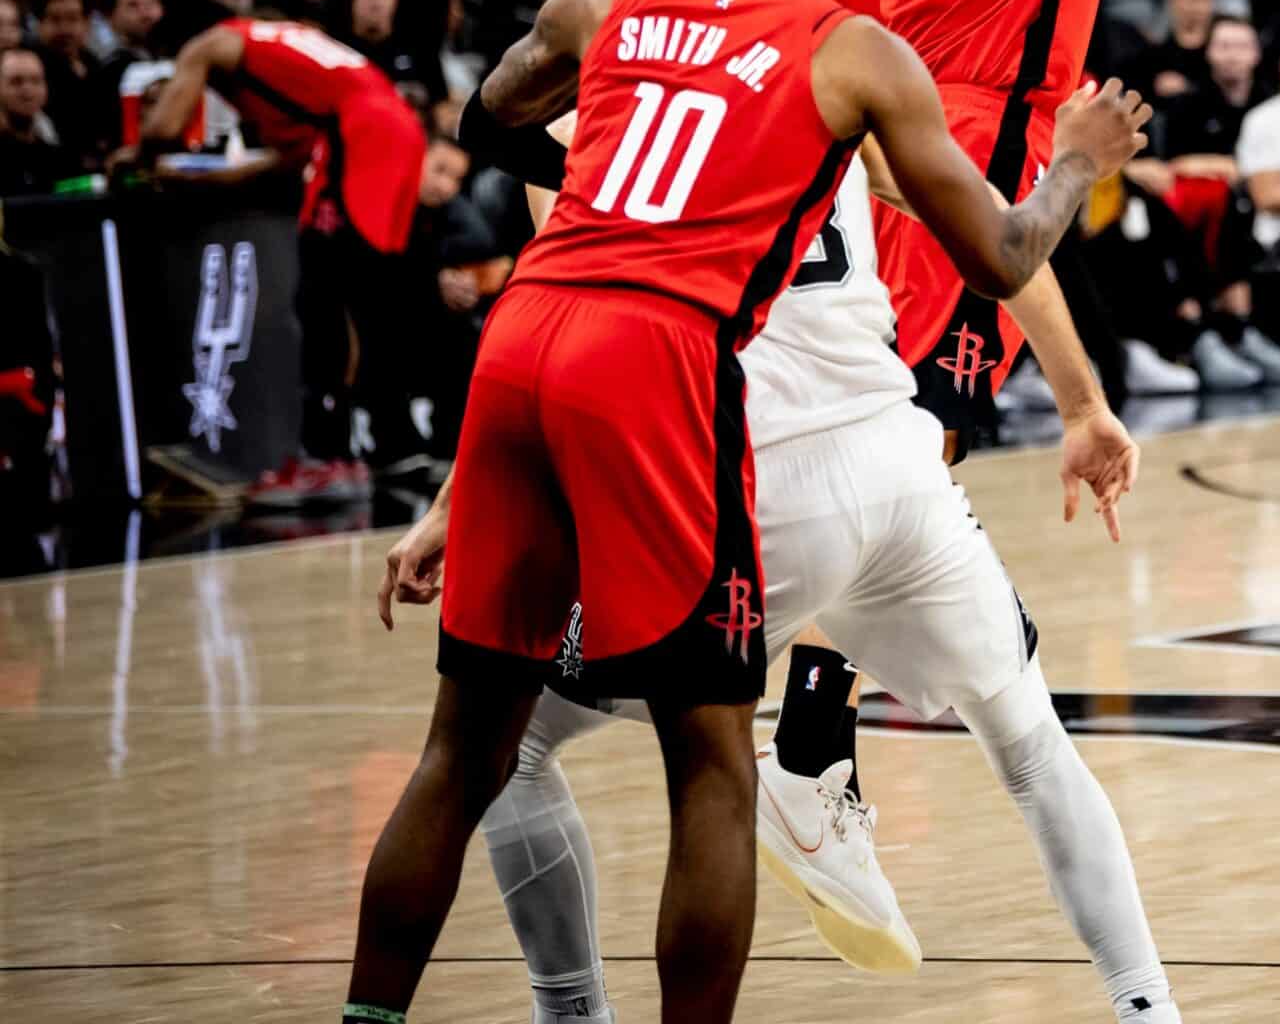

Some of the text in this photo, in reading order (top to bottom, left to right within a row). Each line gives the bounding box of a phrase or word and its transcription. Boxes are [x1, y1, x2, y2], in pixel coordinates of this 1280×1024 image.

[617, 15, 781, 93] SMITH JR.
[590, 80, 729, 225] 10
